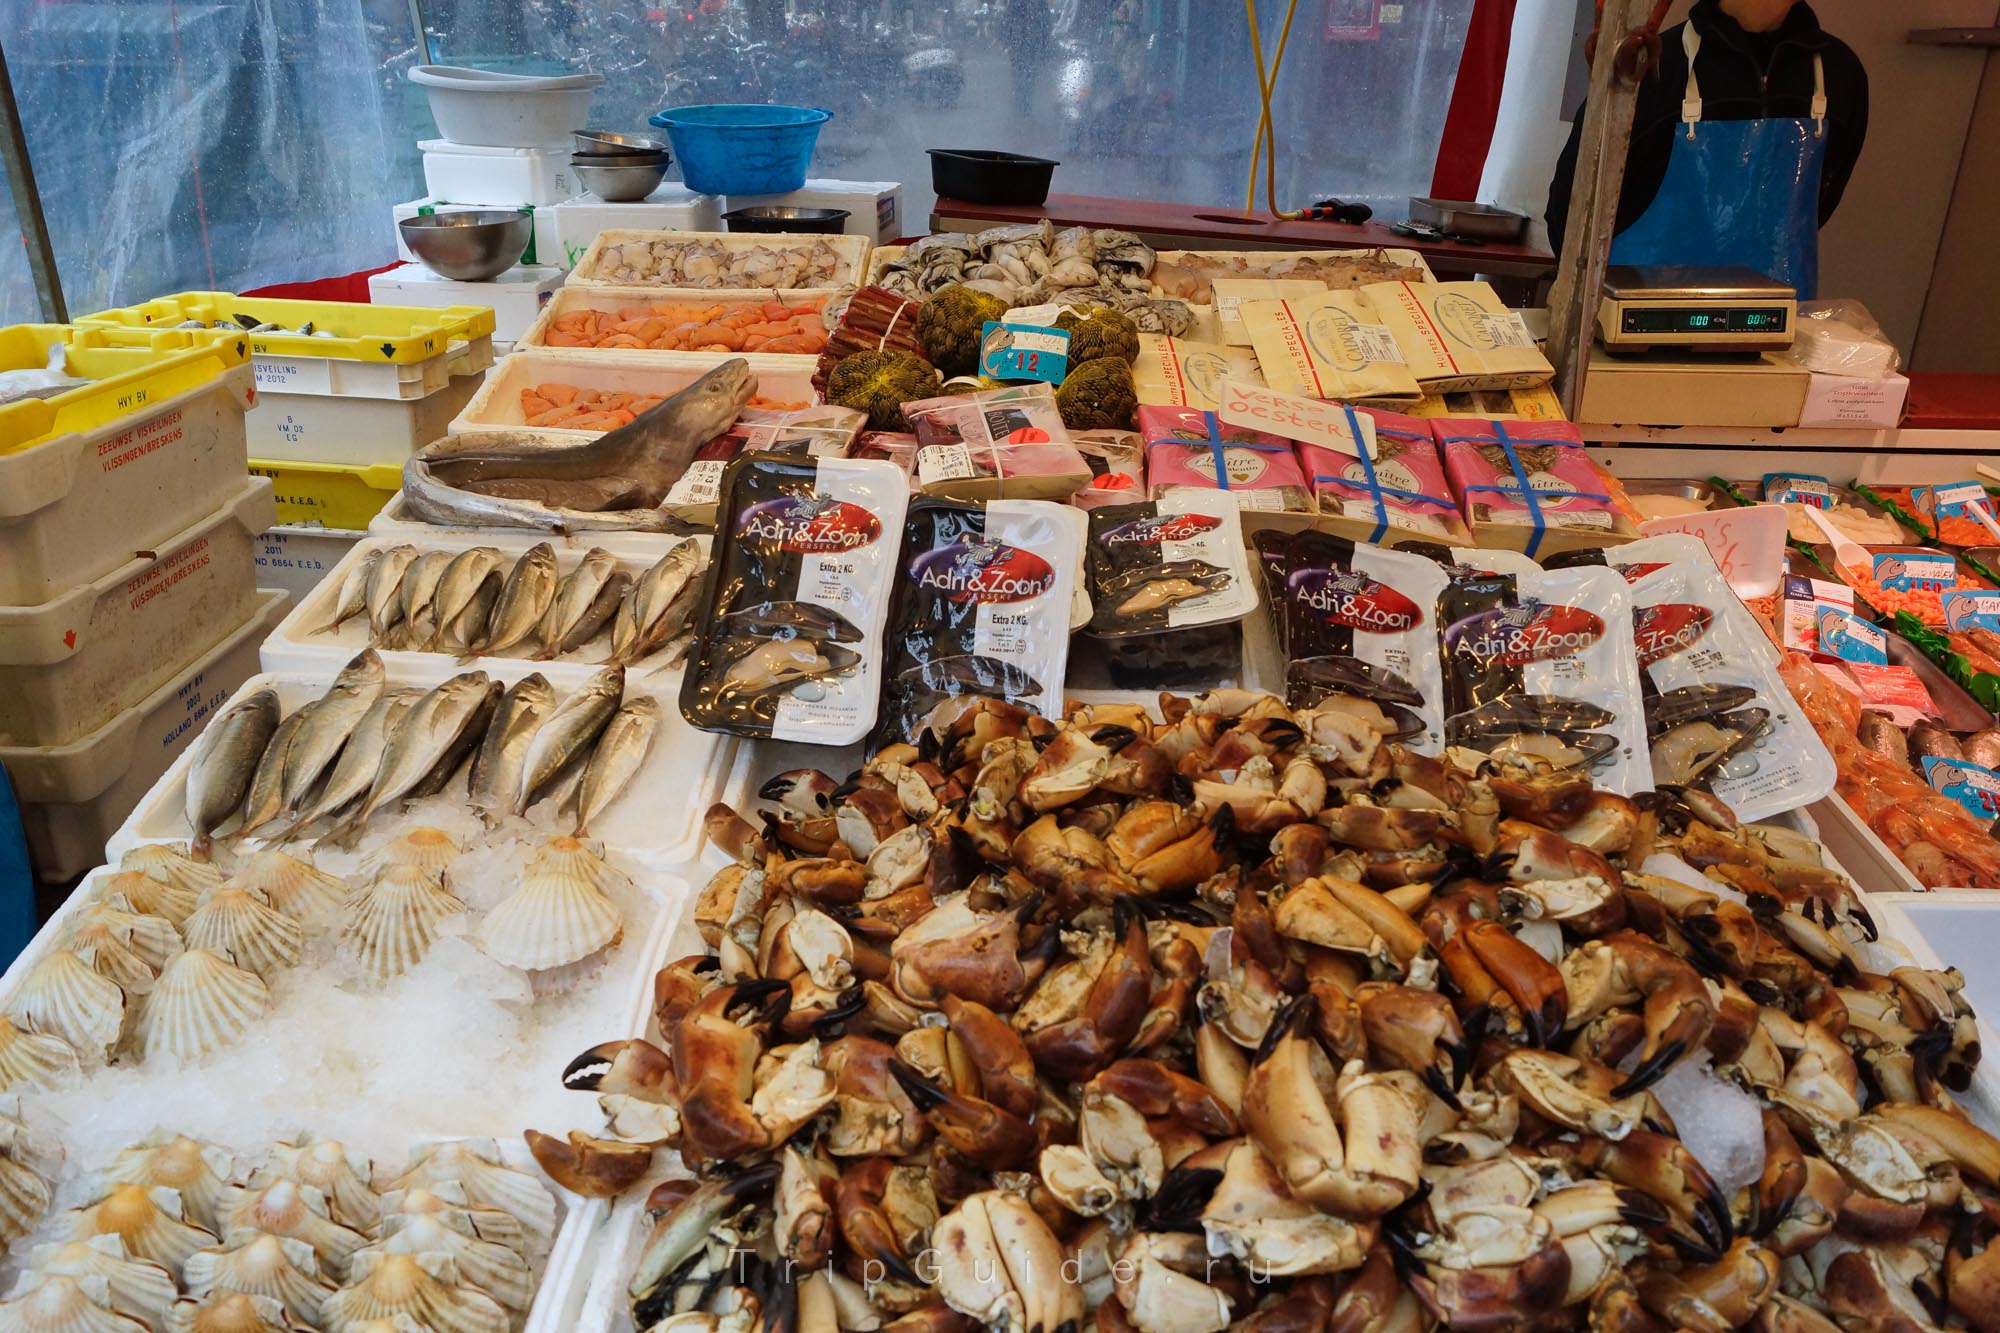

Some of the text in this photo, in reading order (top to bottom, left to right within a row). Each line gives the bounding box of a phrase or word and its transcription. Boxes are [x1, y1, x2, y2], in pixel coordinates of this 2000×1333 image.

[1017, 352, 1039, 371] 12
[267, 375, 286, 383] 2012
[118, 388, 147, 409] HVY BV
[98, 409, 183, 456] ZEEUWSE VISVEILINGEN
[103, 428, 183, 473] VLISSINGEN/BRESKENS
[1960, 500, 1992, 519] 20
[820, 562, 837, 573] Extra
[838, 564, 842, 574] 2
[127, 566, 160, 595] ZEEUWSE
[992, 614, 1009, 624] Extra
[1011, 616, 1016, 624] 2
